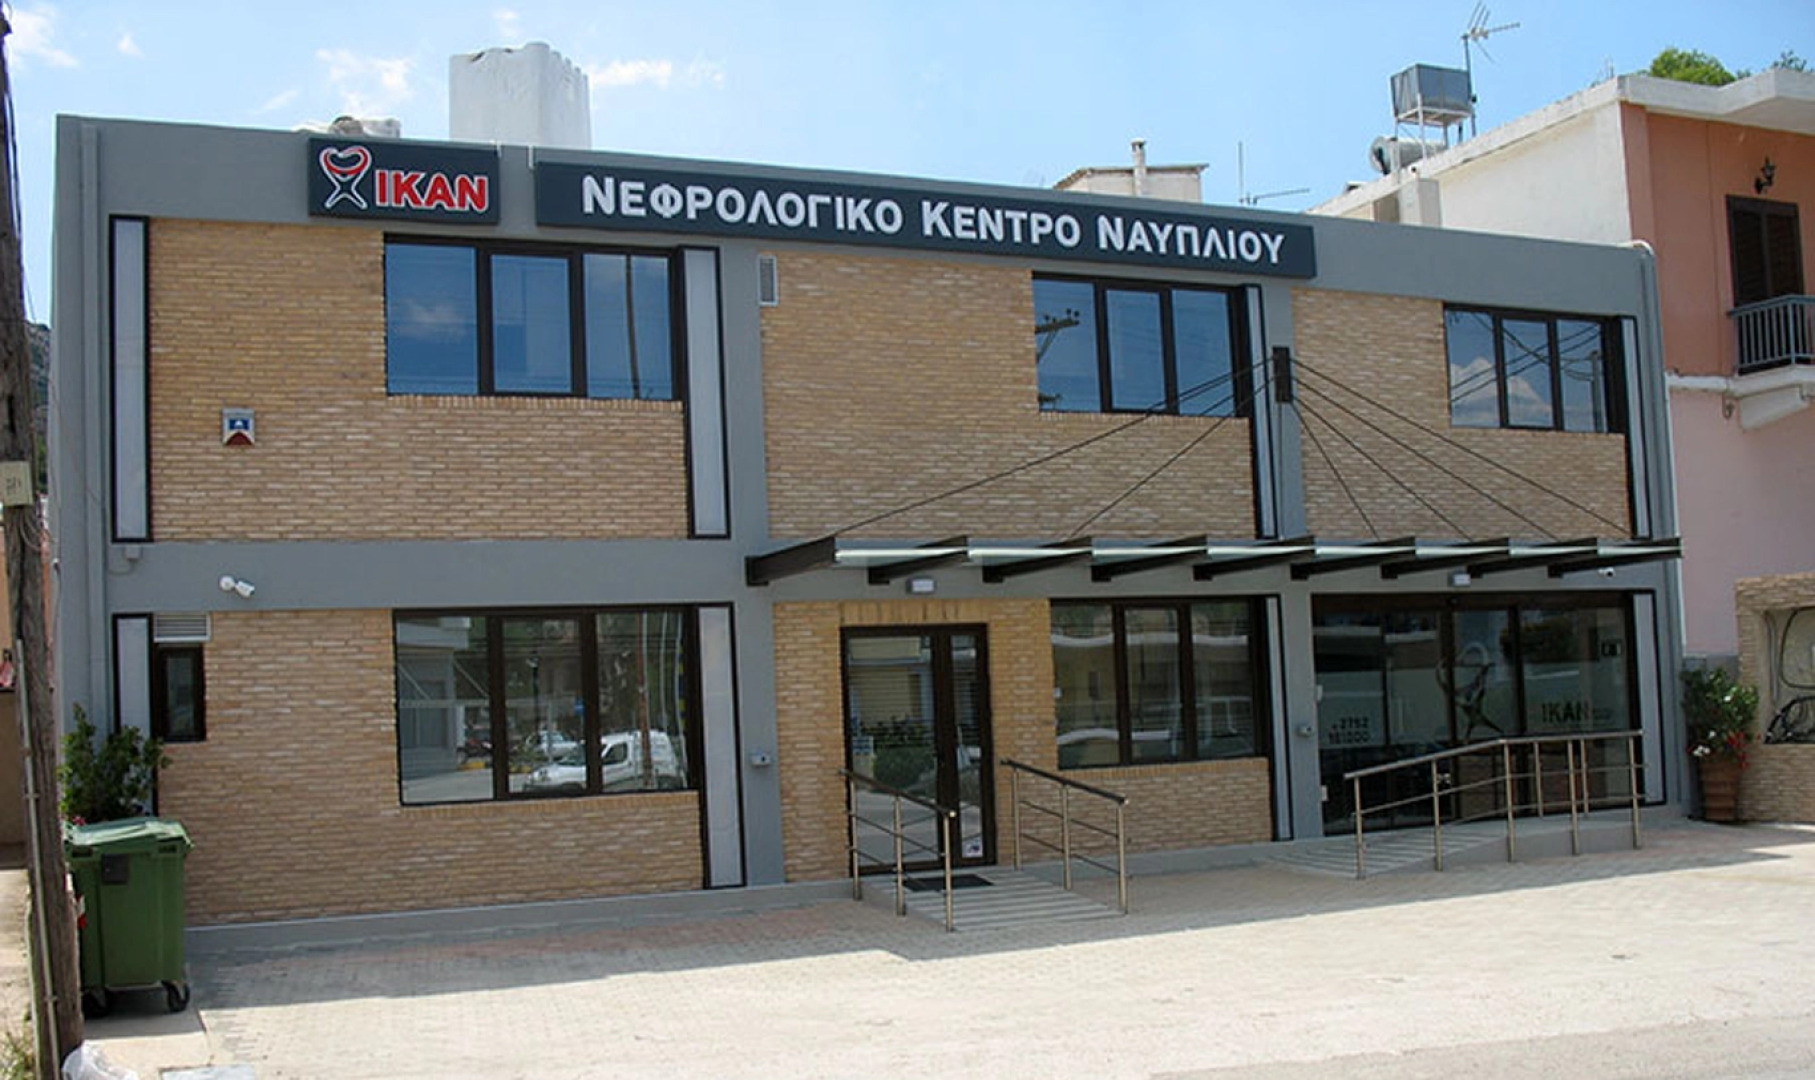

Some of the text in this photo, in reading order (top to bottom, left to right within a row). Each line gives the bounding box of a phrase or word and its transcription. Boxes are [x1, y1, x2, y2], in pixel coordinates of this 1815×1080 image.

[582, 174, 1286, 264] ΝΕΦΡΟΛΟΓΙΚΟ ΚΕΝΤΡΟ ΝΑΥΠΛΙΟΥ
